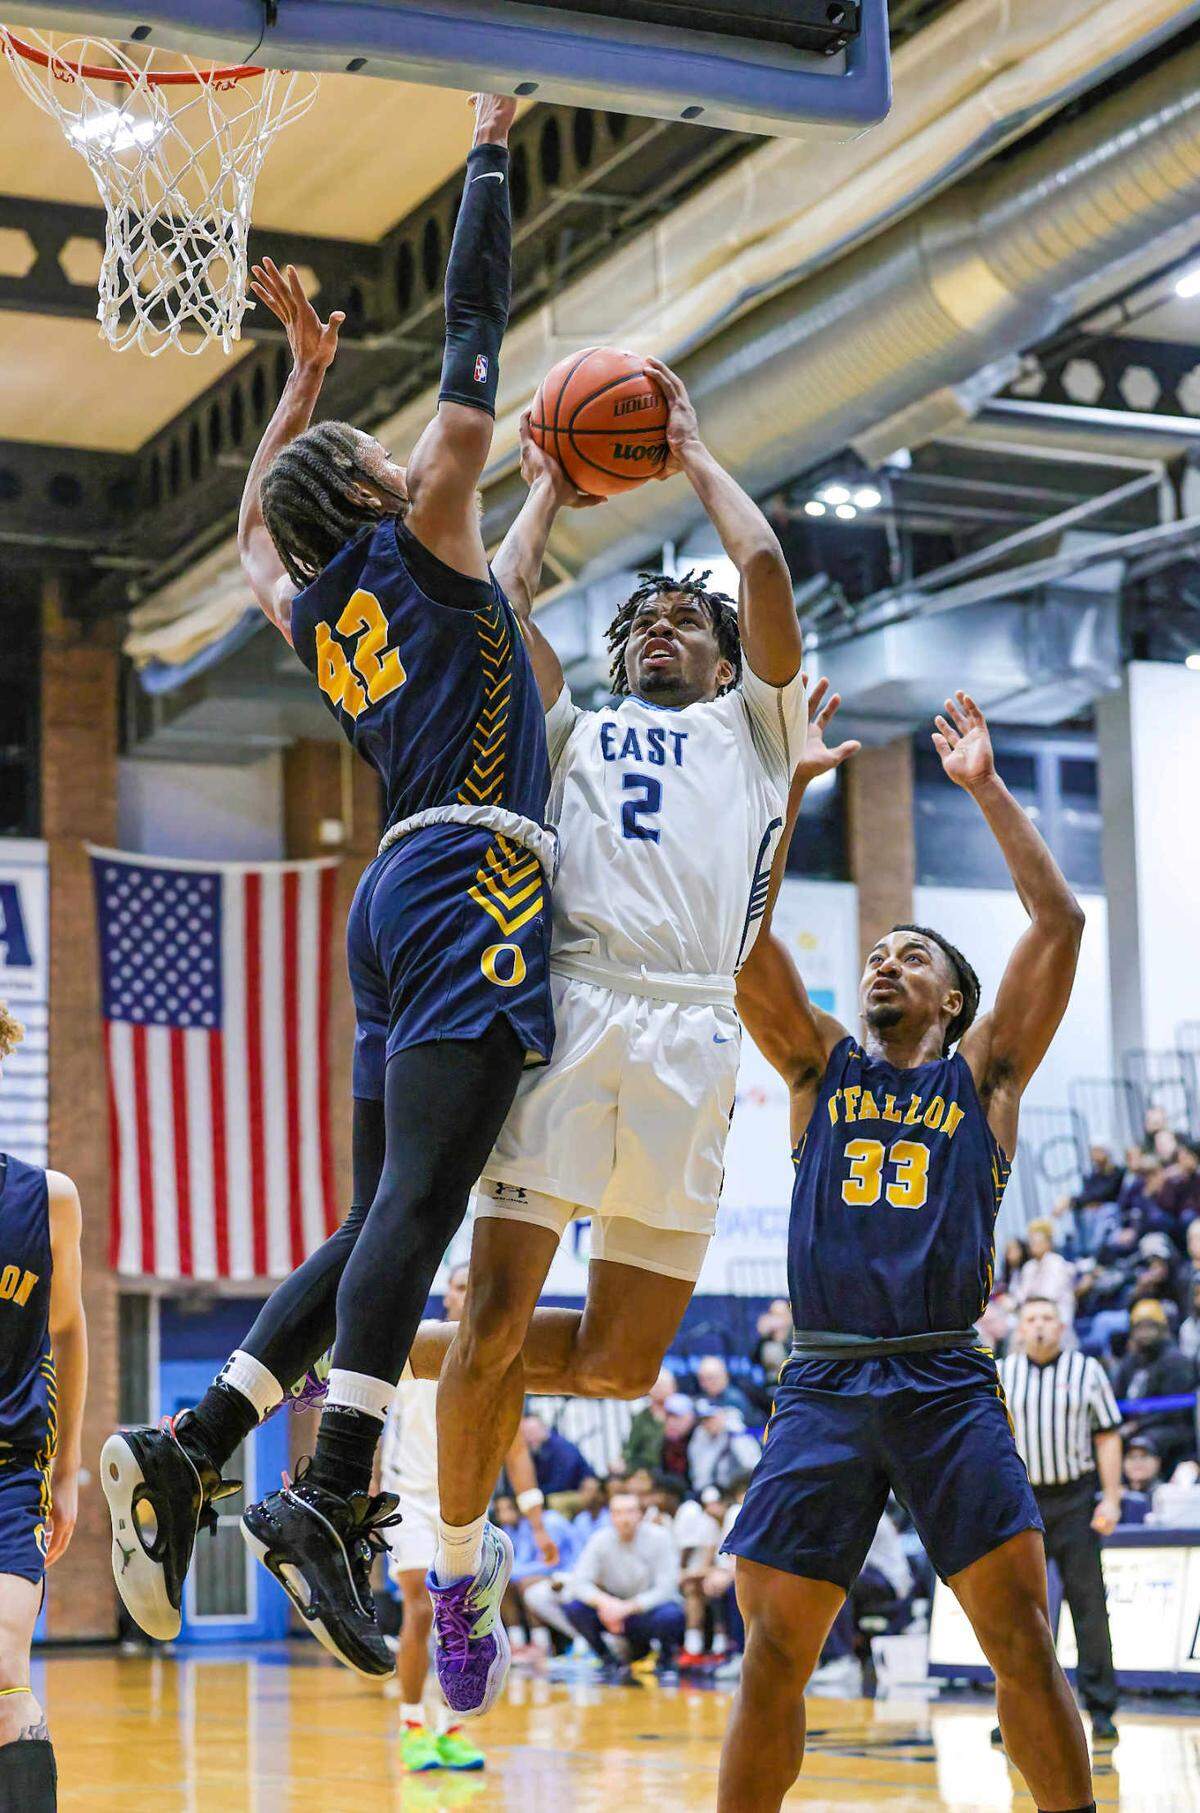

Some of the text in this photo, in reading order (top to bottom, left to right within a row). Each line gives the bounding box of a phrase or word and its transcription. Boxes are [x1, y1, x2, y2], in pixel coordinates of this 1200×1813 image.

[314, 587, 407, 722] 42
[600, 722, 688, 767] EAST
[621, 771, 663, 845] 2
[480, 943, 527, 988] O
[841, 1138, 931, 1210] 33
